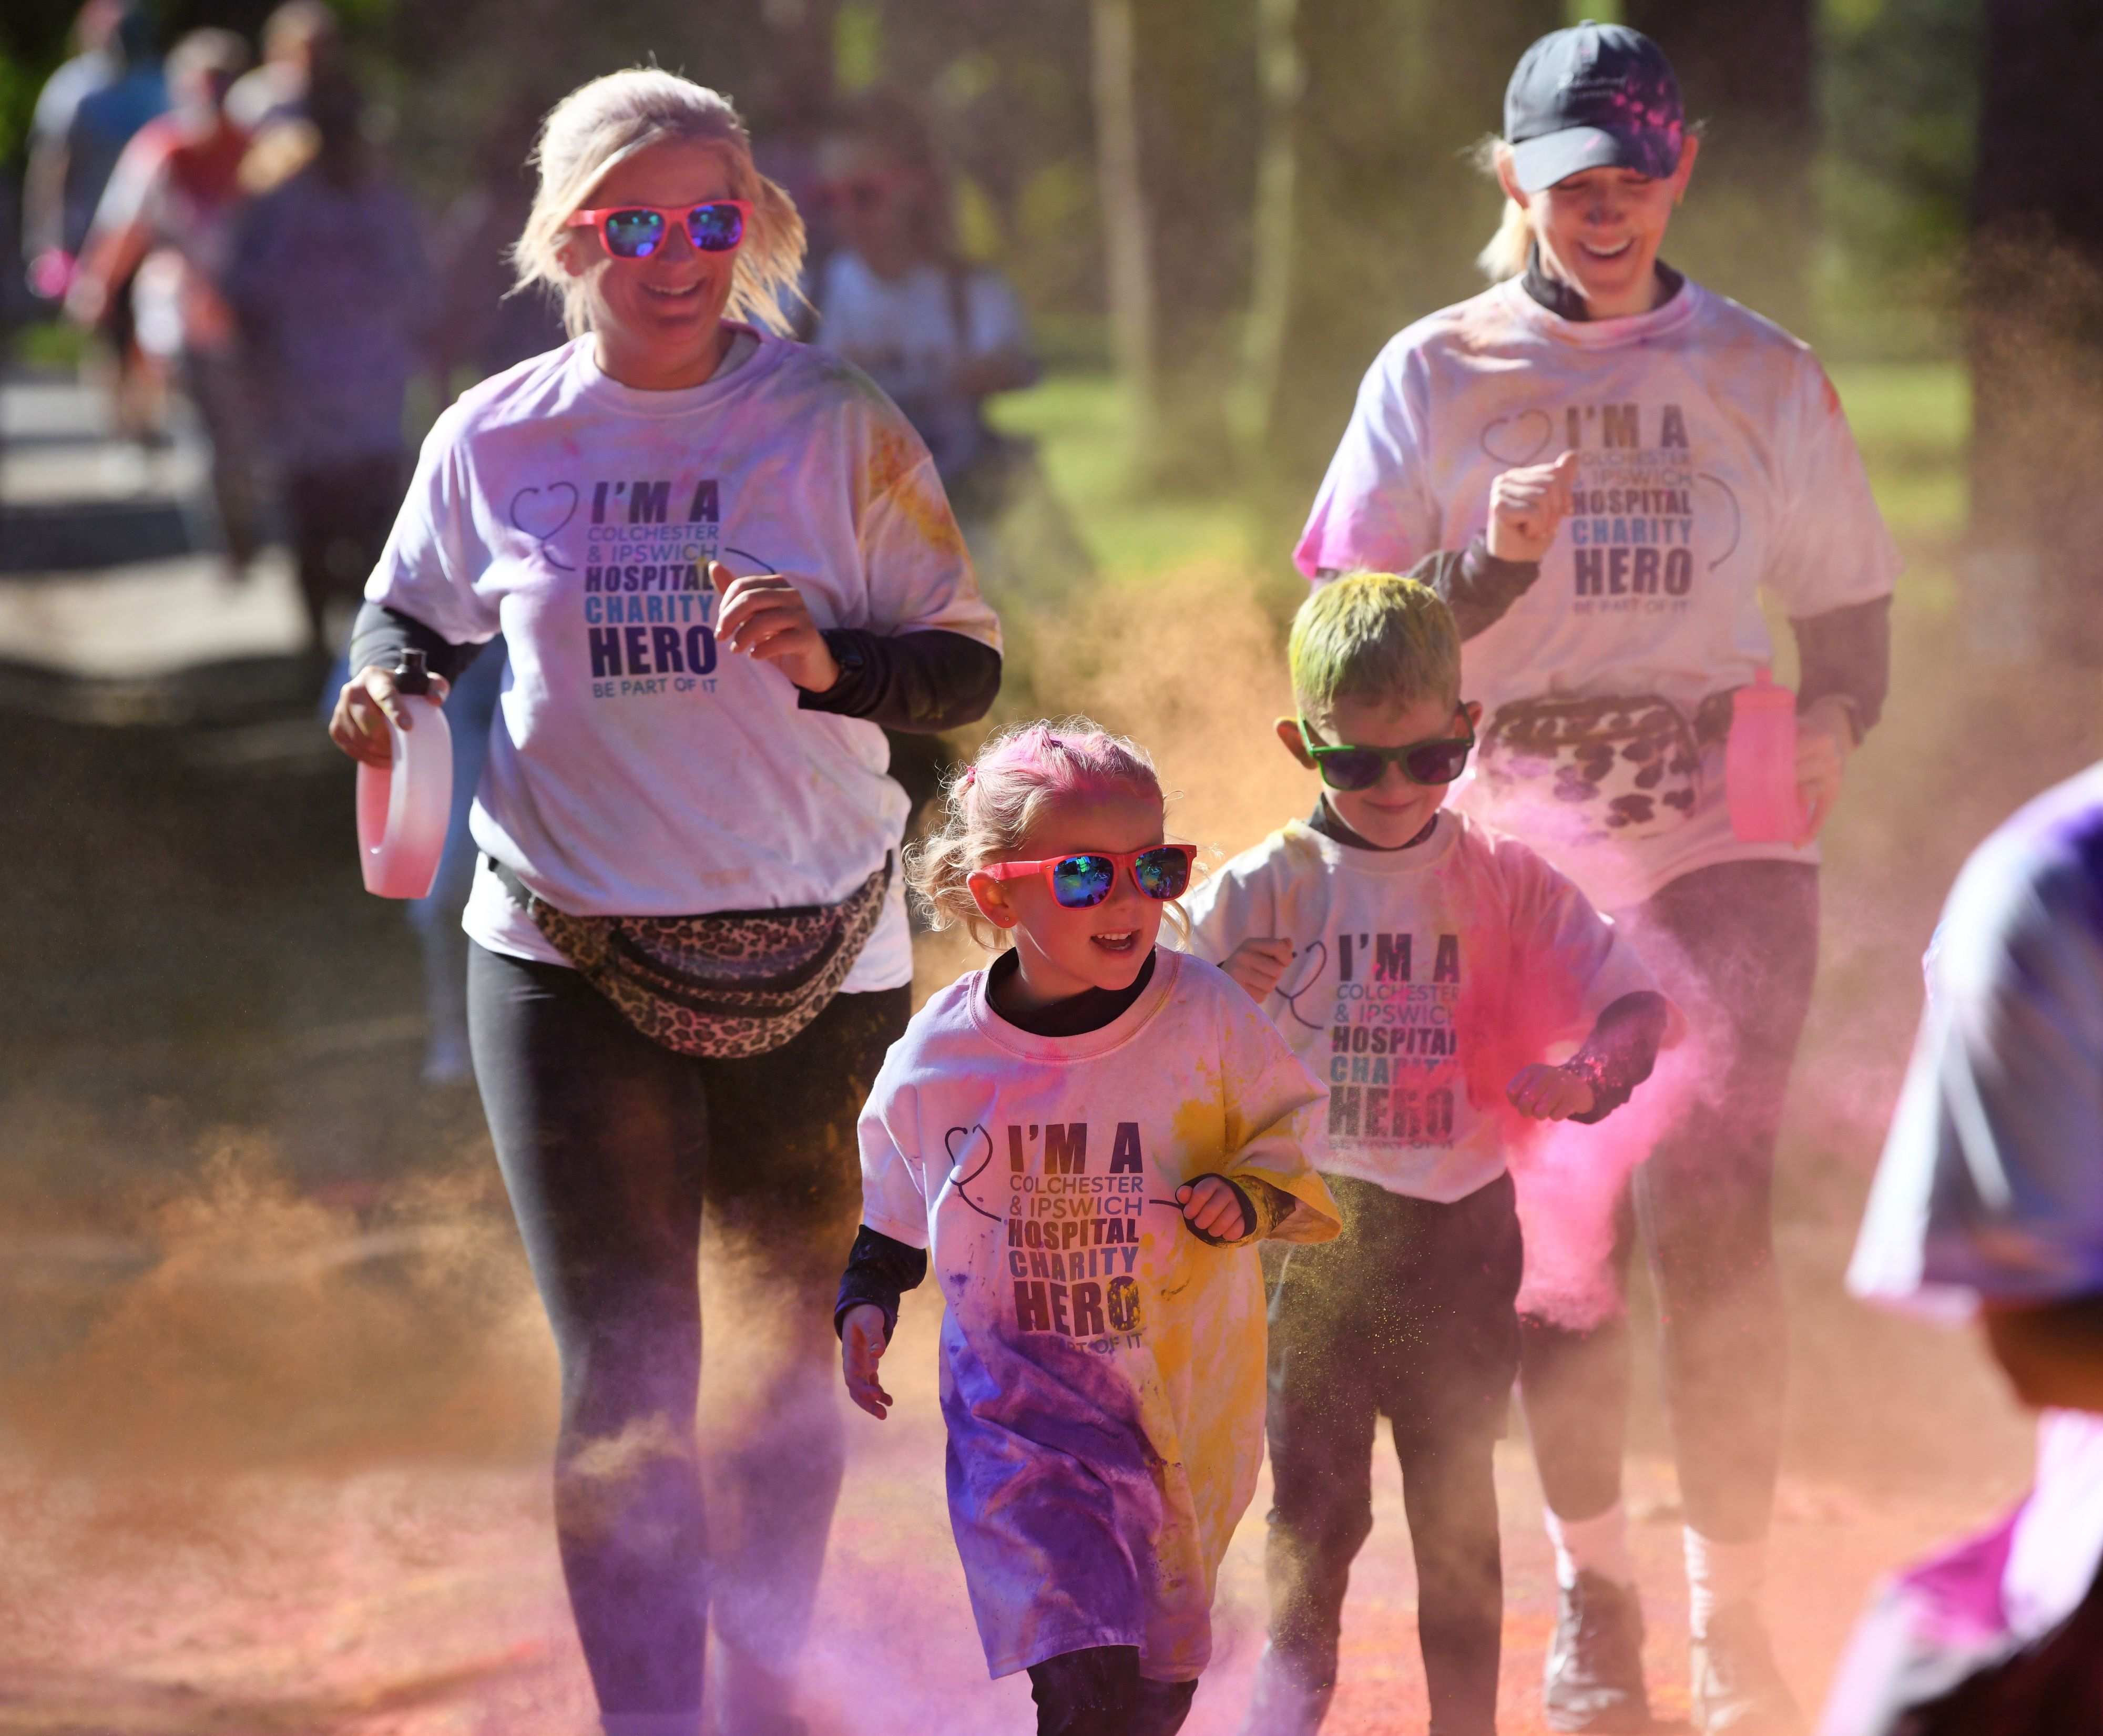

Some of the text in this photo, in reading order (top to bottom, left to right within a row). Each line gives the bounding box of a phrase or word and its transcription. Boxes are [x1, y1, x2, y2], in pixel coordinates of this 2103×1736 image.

[1566, 403, 1689, 449] I'M A
[591, 479, 719, 524] I'M A
[1573, 488, 1693, 515] HOSPITAL
[587, 525, 719, 542] COLCHESTER
[1570, 517, 1693, 544] CHARITY
[587, 543, 718, 563] & IPSWICH
[586, 564, 714, 592] HOSPITAL
[1574, 548, 1693, 596] HERO
[585, 595, 713, 624] CHARITY
[588, 626, 718, 677] HERO
[593, 678, 718, 698] BE PART OF IT
[1339, 933, 1460, 984] I'M A
[1335, 1004, 1349, 1023] &
[1329, 1086, 1454, 1137] HERO
[1008, 1122, 1143, 1174] I'M A
[1010, 1175, 1143, 1194] COLCHESTER
[1009, 1196, 1142, 1218] & IPSWICH
[1008, 1218, 1139, 1250] HOSPITAL
[1008, 1246, 1139, 1282] CHARITY
[1013, 1275, 1140, 1337] HERO
[1095, 1336, 1119, 1354] OF
[1127, 1333, 1142, 1349] IT
